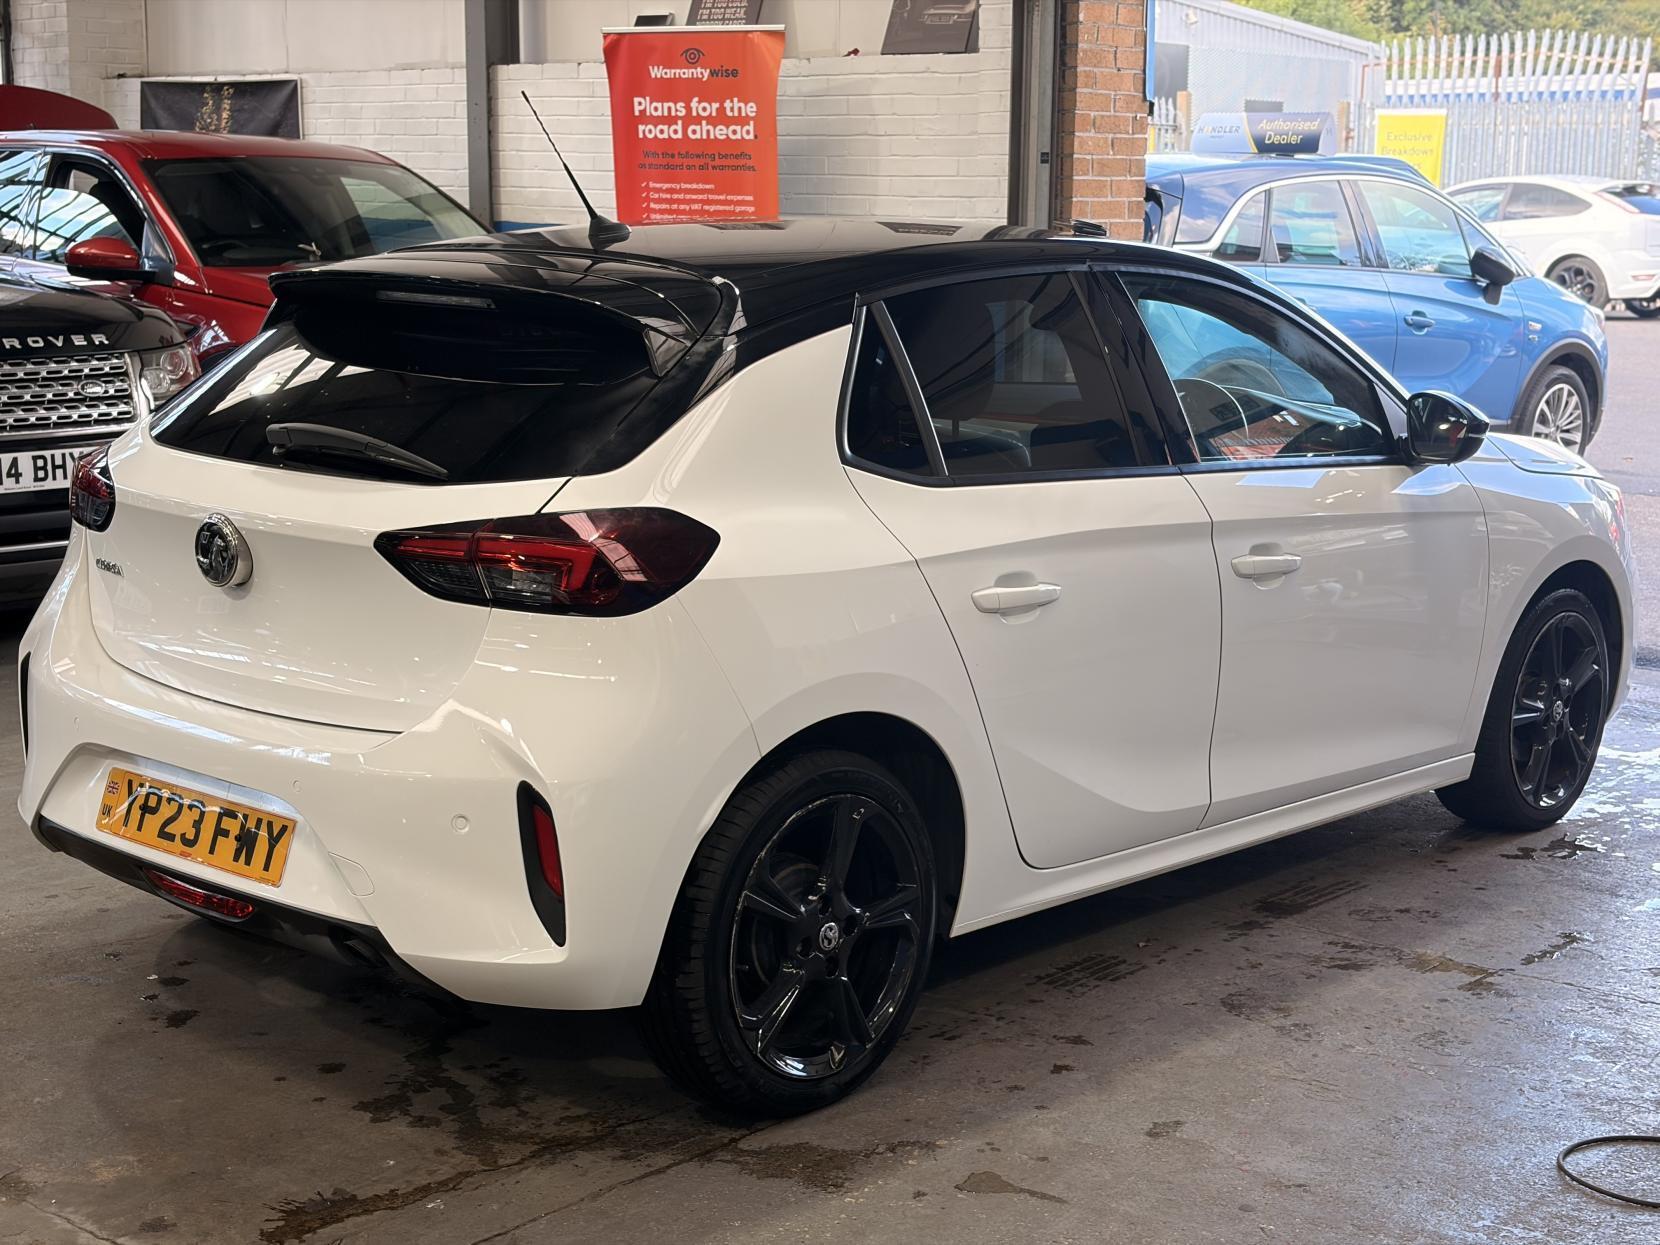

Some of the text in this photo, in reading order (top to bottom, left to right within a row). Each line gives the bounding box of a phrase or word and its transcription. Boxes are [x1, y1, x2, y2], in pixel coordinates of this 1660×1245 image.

[697, 9, 710, 20] I'M
[710, 8, 725, 19] TOO
[649, 65, 739, 81] Warrantywise
[633, 96, 757, 117] Plans for the
[638, 120, 758, 140] road ahead.
[1258, 118, 1321, 130] Authorised
[1264, 131, 1303, 144] Dealer
[1386, 131, 1433, 141] Exclusive
[642, 150, 752, 161] With the following benefits
[648, 162, 684, 170] standard
[685, 163, 697, 171] on
[698, 162, 709, 171] all
[711, 163, 757, 172] warranties.
[649, 181, 715, 190] Emergency breakdown
[649, 202, 670, 210] Repairs
[703, 204, 734, 212] registered
[1, 333, 109, 349] ROVER
[102, 805, 114, 817] UK
[122, 778, 289, 872] YP23 FWY
